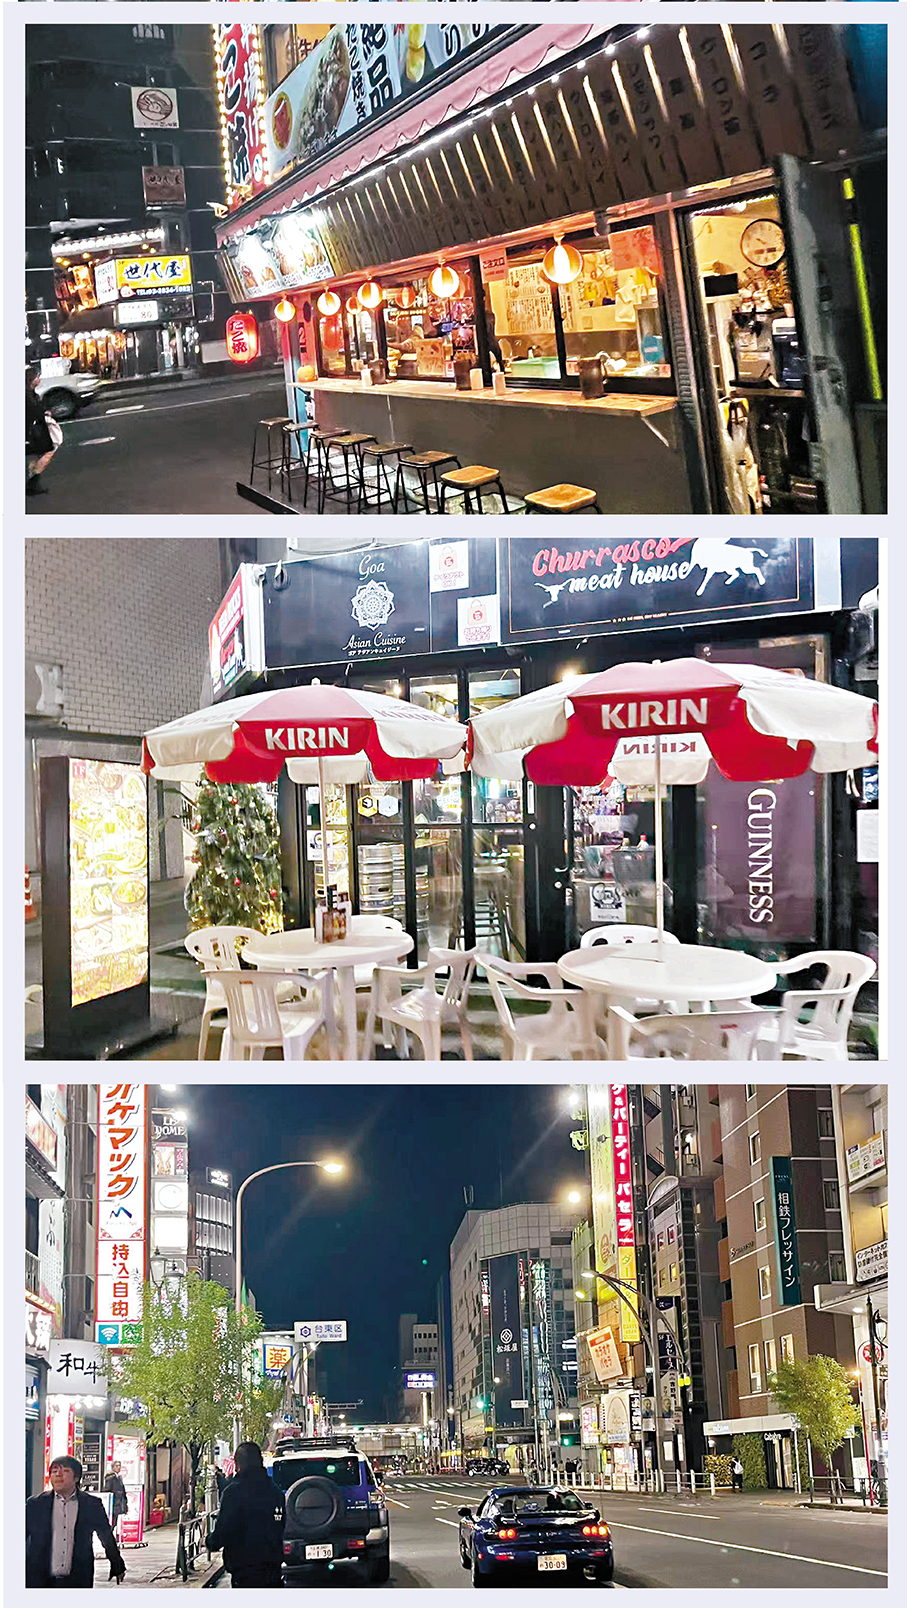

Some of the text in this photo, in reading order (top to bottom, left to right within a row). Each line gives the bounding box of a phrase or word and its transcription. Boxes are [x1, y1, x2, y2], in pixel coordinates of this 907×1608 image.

[123, 260, 182, 280] 世代屋
[358, 554, 386, 581] Goa
[531, 537, 676, 578] Churrasco
[567, 560, 690, 594] meat house
[342, 631, 407, 651] Asian Cuisine
[600, 697, 709, 731] KIRIN
[264, 726, 350, 751] KIRIN
[747, 787, 777, 924] GUINNESS
[777, 1192, 796, 1288] 相鉄フレッサイン
[112, 1244, 130, 1317] 持入自由
[314, 1324, 342, 1334] 台東区
[56, 1352, 99, 1384] 和牛
[270, 1347, 288, 1368] 薬
